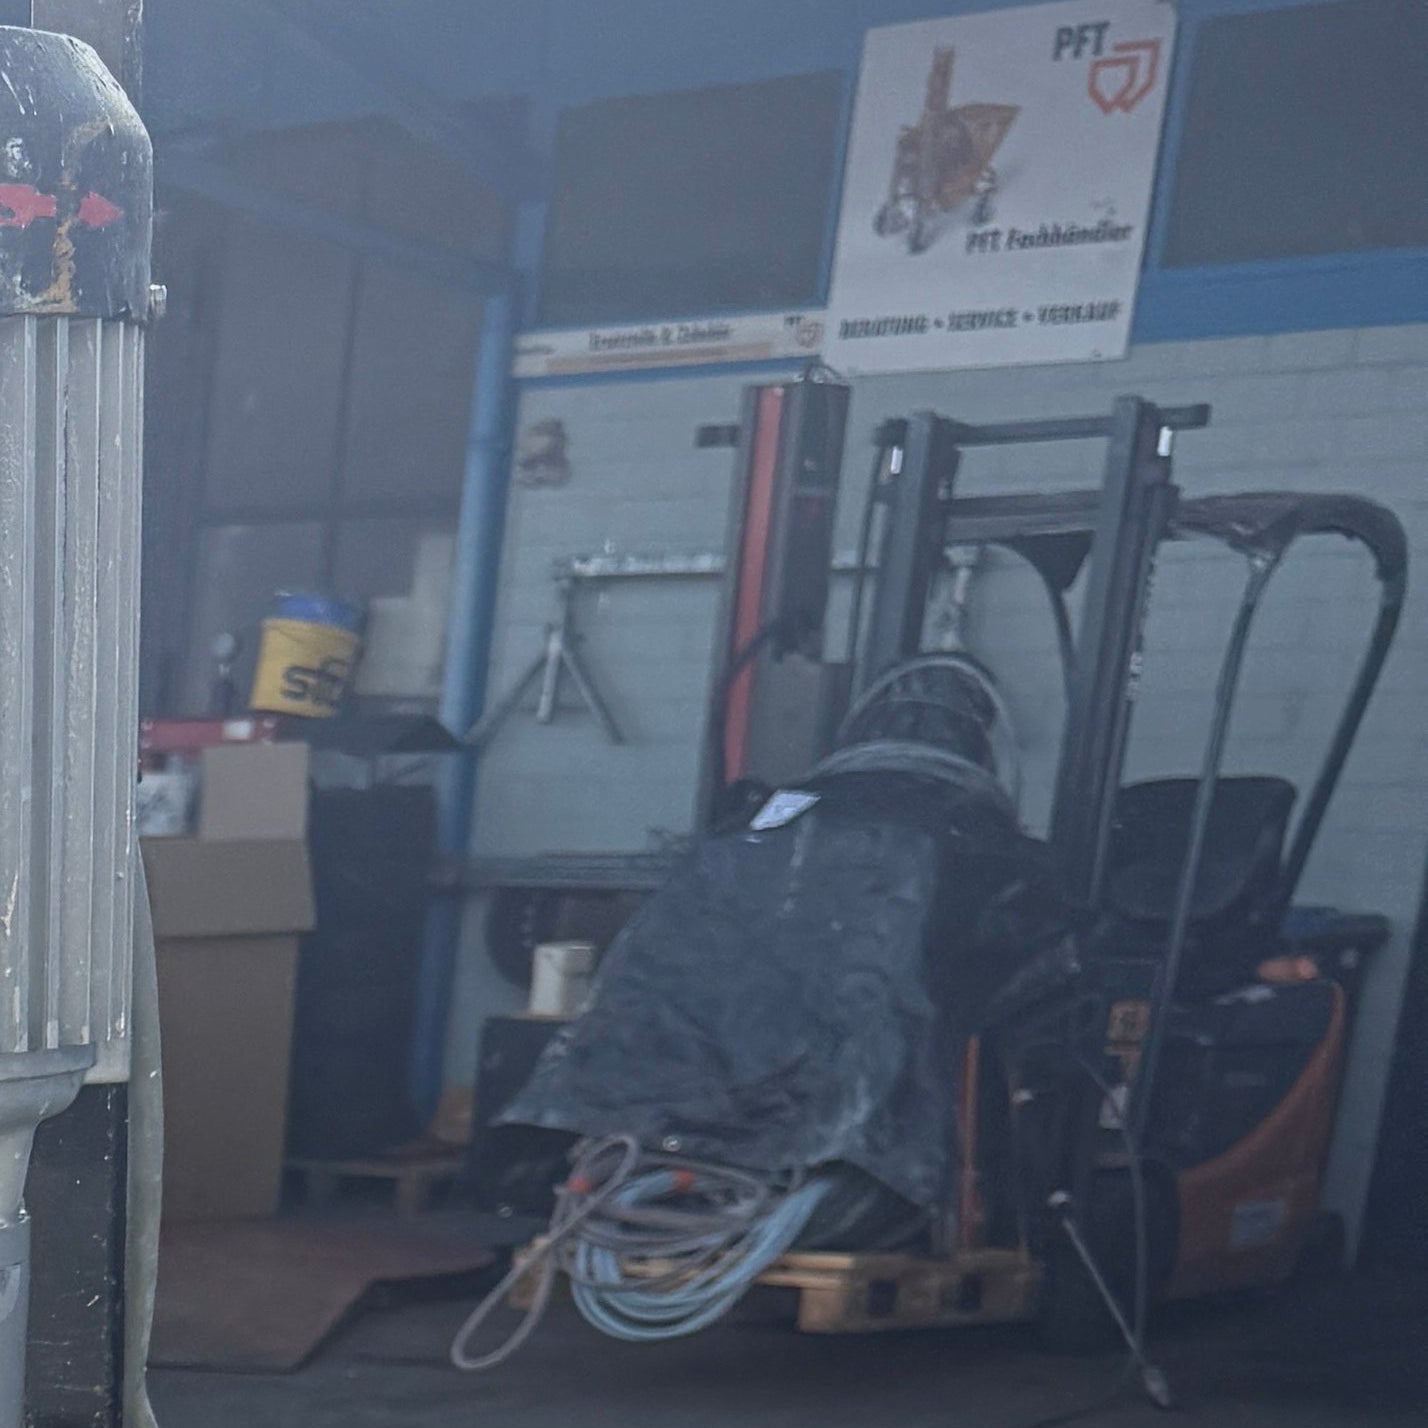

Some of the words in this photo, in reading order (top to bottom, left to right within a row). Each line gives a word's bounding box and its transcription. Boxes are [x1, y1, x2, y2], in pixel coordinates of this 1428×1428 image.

[1052, 20, 1111, 60] PFT
[965, 228, 1001, 254] PFT
[1005, 219, 1133, 250] Fachhändler
[839, 313, 929, 339] BERATUNG
[946, 307, 1017, 331] SERVICE
[1038, 299, 1123, 324] VERKAUF
